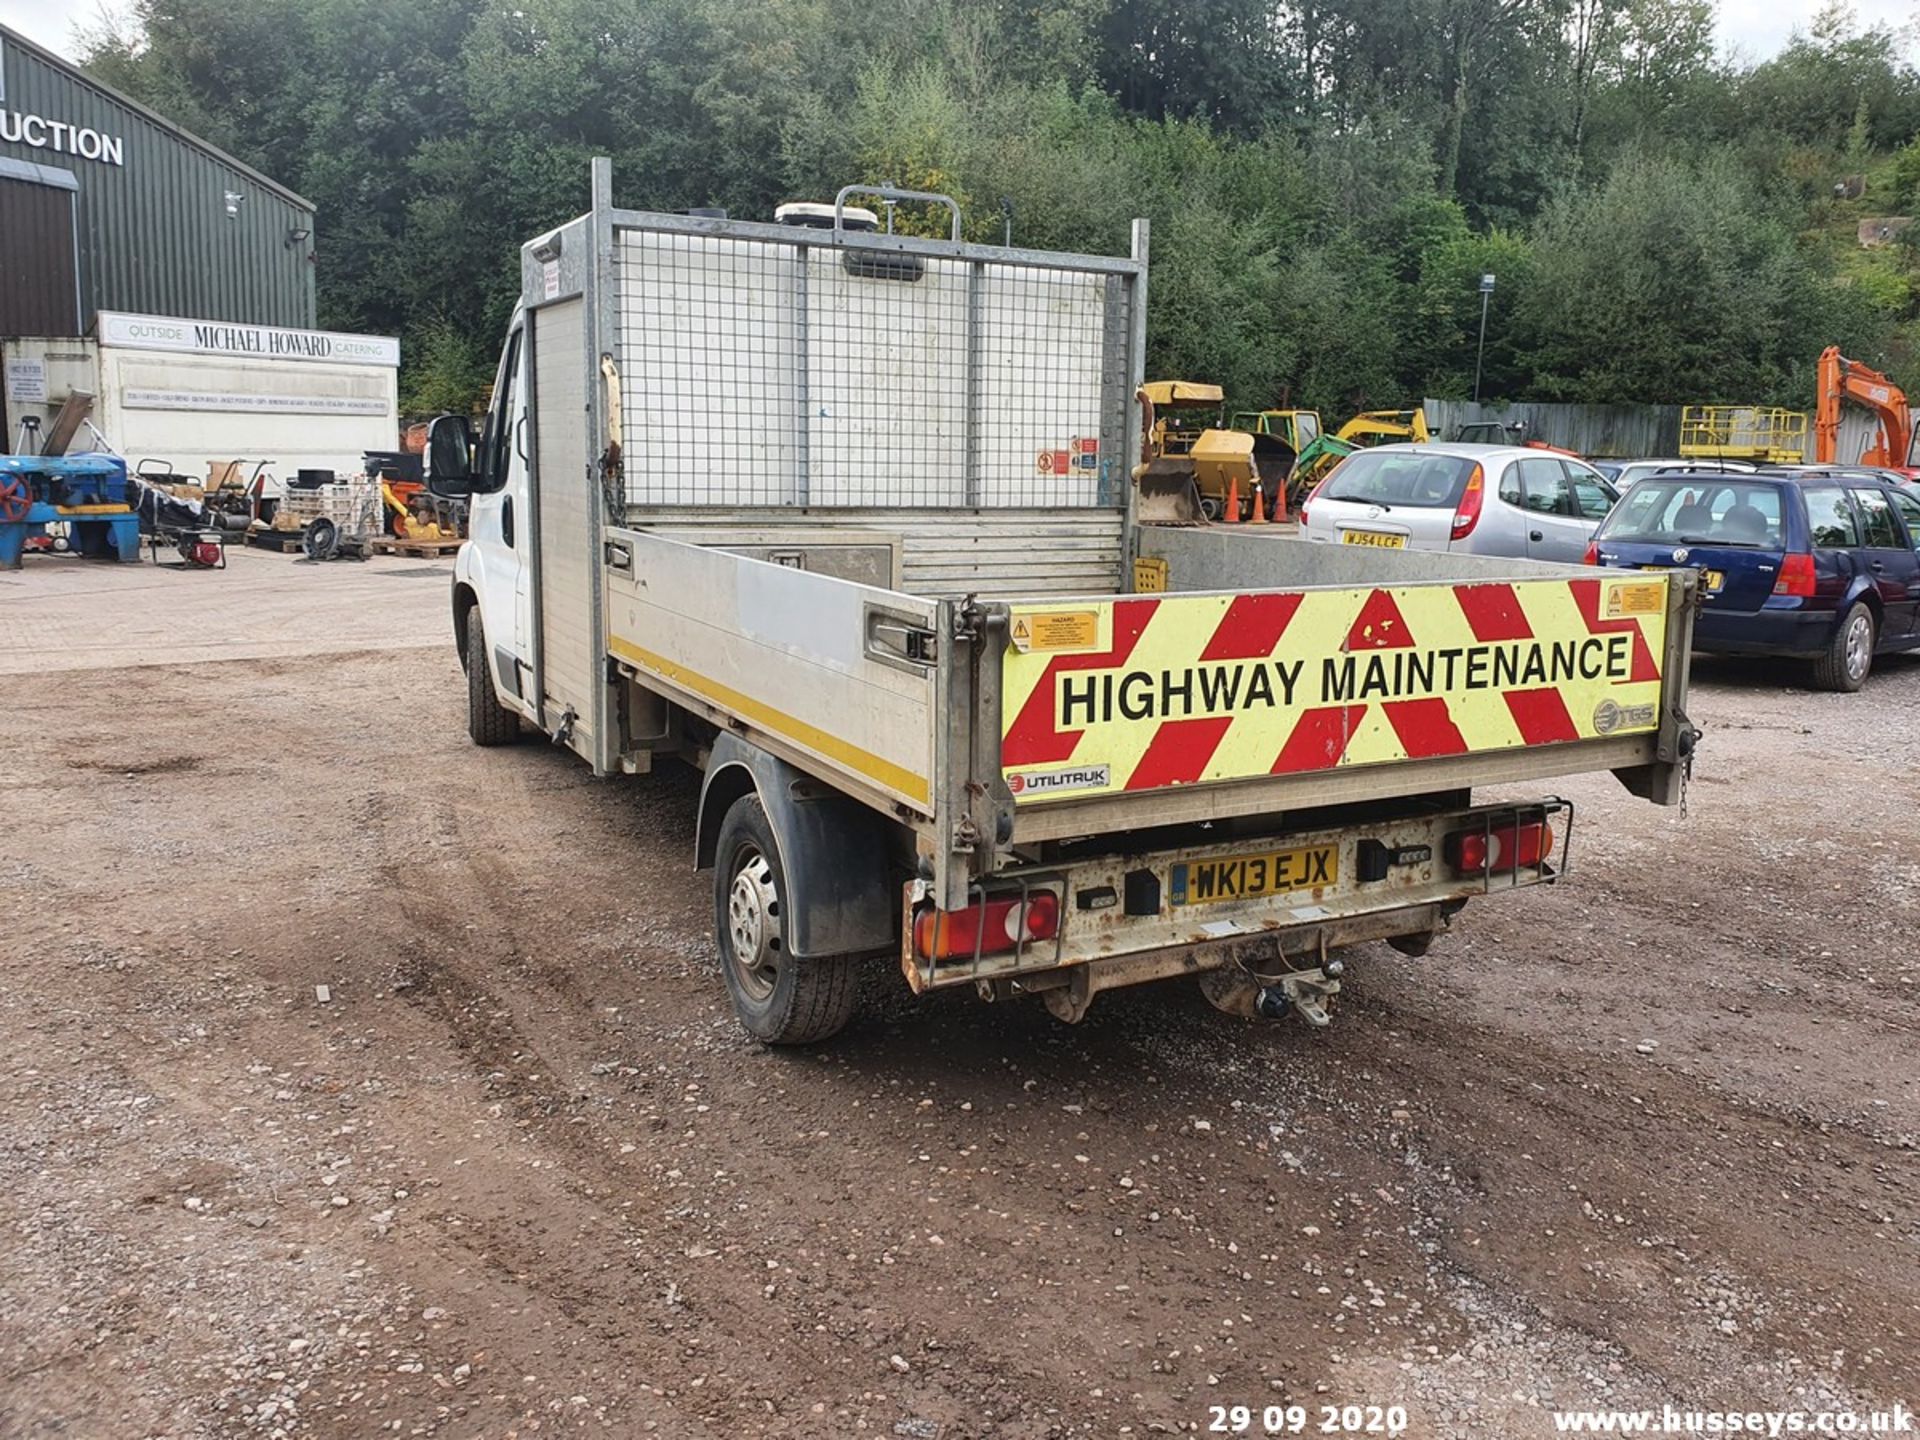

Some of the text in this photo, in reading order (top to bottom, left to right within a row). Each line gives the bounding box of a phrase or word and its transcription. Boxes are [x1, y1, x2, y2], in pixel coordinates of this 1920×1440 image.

[194, 325, 266, 353] MICHAEL
[269, 332, 331, 357] HOWARD
[335, 343, 383, 356] CATERING
[1347, 532, 1375, 546] WJ54
[1061, 636, 1628, 726] HIGHWAY MAINTENANCE
[1026, 769, 1105, 788] UTILITRUK
[1197, 849, 1330, 899] WK13 EJX
